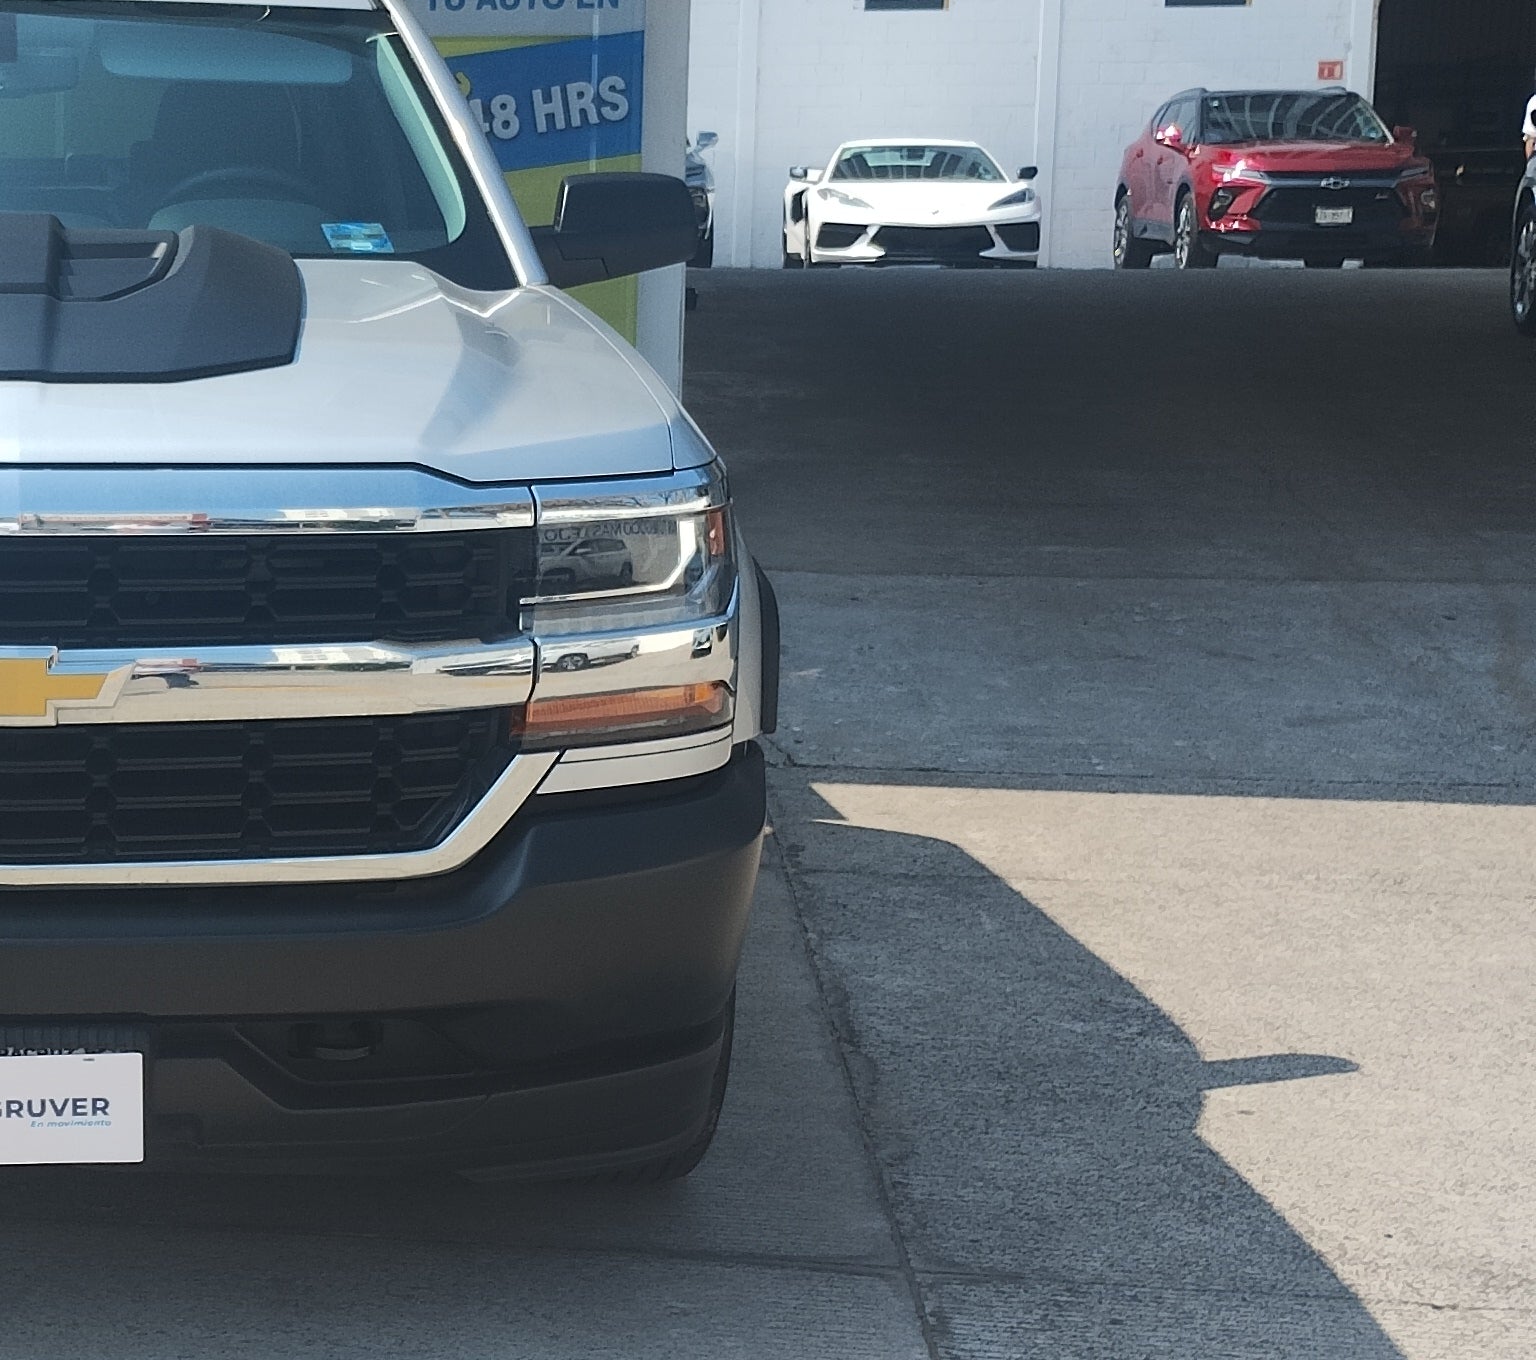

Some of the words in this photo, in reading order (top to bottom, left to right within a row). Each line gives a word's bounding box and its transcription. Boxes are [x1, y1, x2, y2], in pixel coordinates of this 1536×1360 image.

[532, 75, 629, 134] HRS
[30, 1120, 44, 1128] En
[46, 1119, 112, 1128] movimiento
